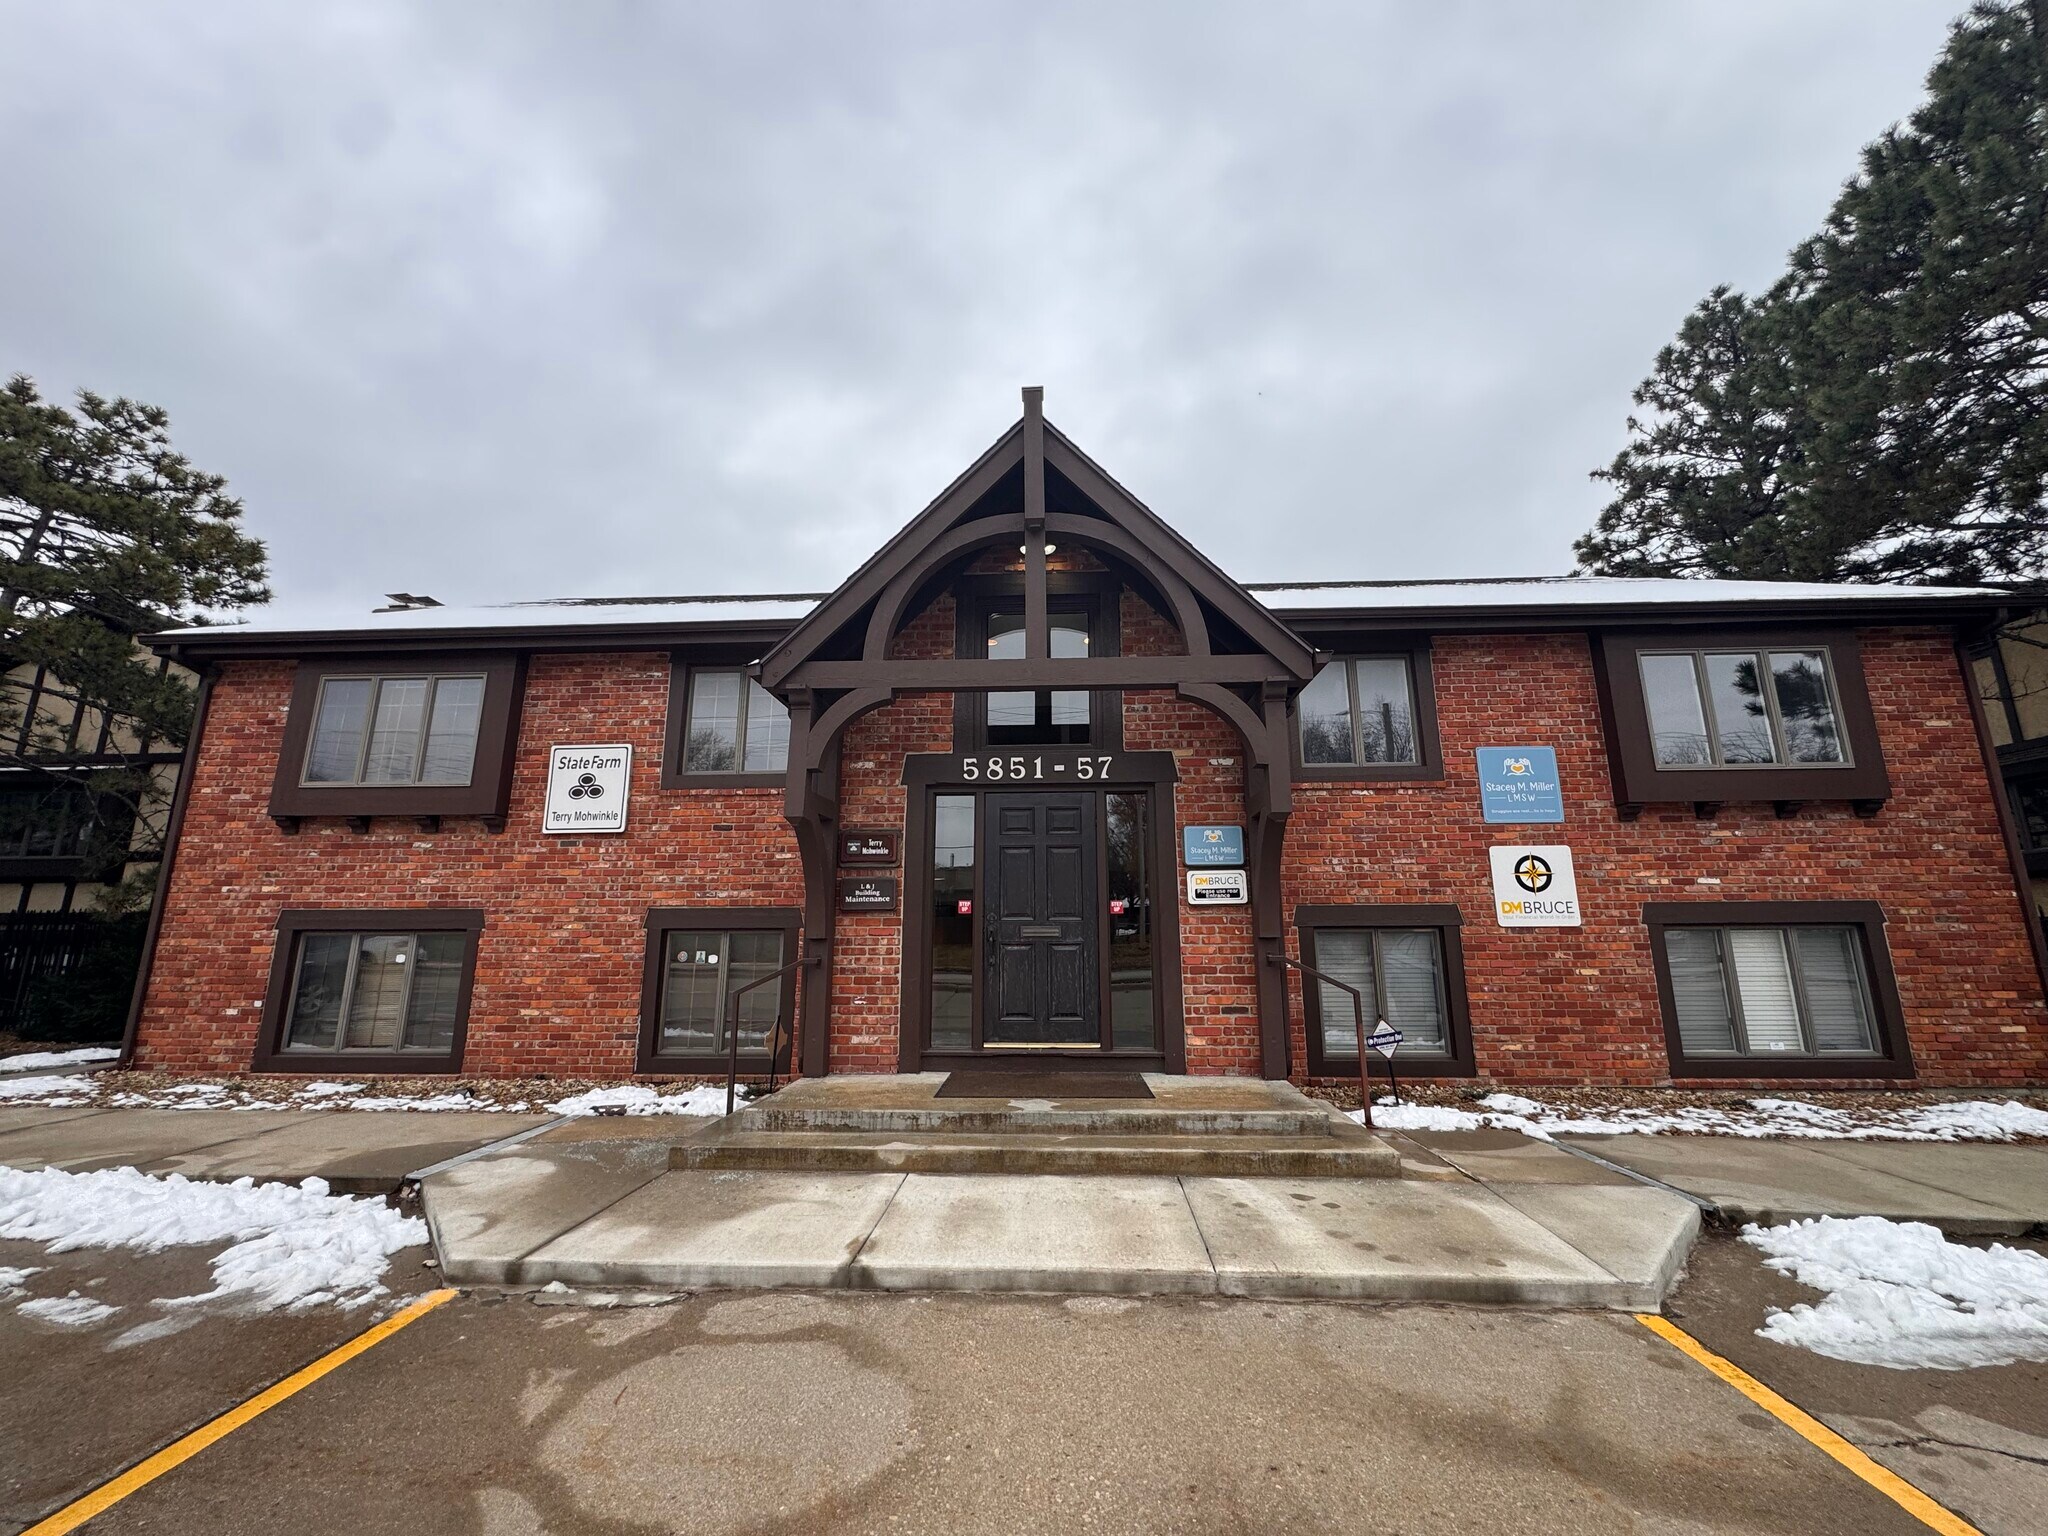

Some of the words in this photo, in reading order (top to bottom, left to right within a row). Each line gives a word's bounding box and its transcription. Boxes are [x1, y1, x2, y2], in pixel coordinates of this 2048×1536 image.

[1486, 782, 1516, 793] Stacey
[1517, 782, 1528, 791] M.
[1529, 781, 1555, 791] Miller
[552, 811, 572, 824] Terry
[574, 810, 619, 822] Mohwinkle
[868, 838, 883, 847] Terry
[1190, 847, 1211, 855] Stacey
[1220, 846, 1238, 854] Miller
